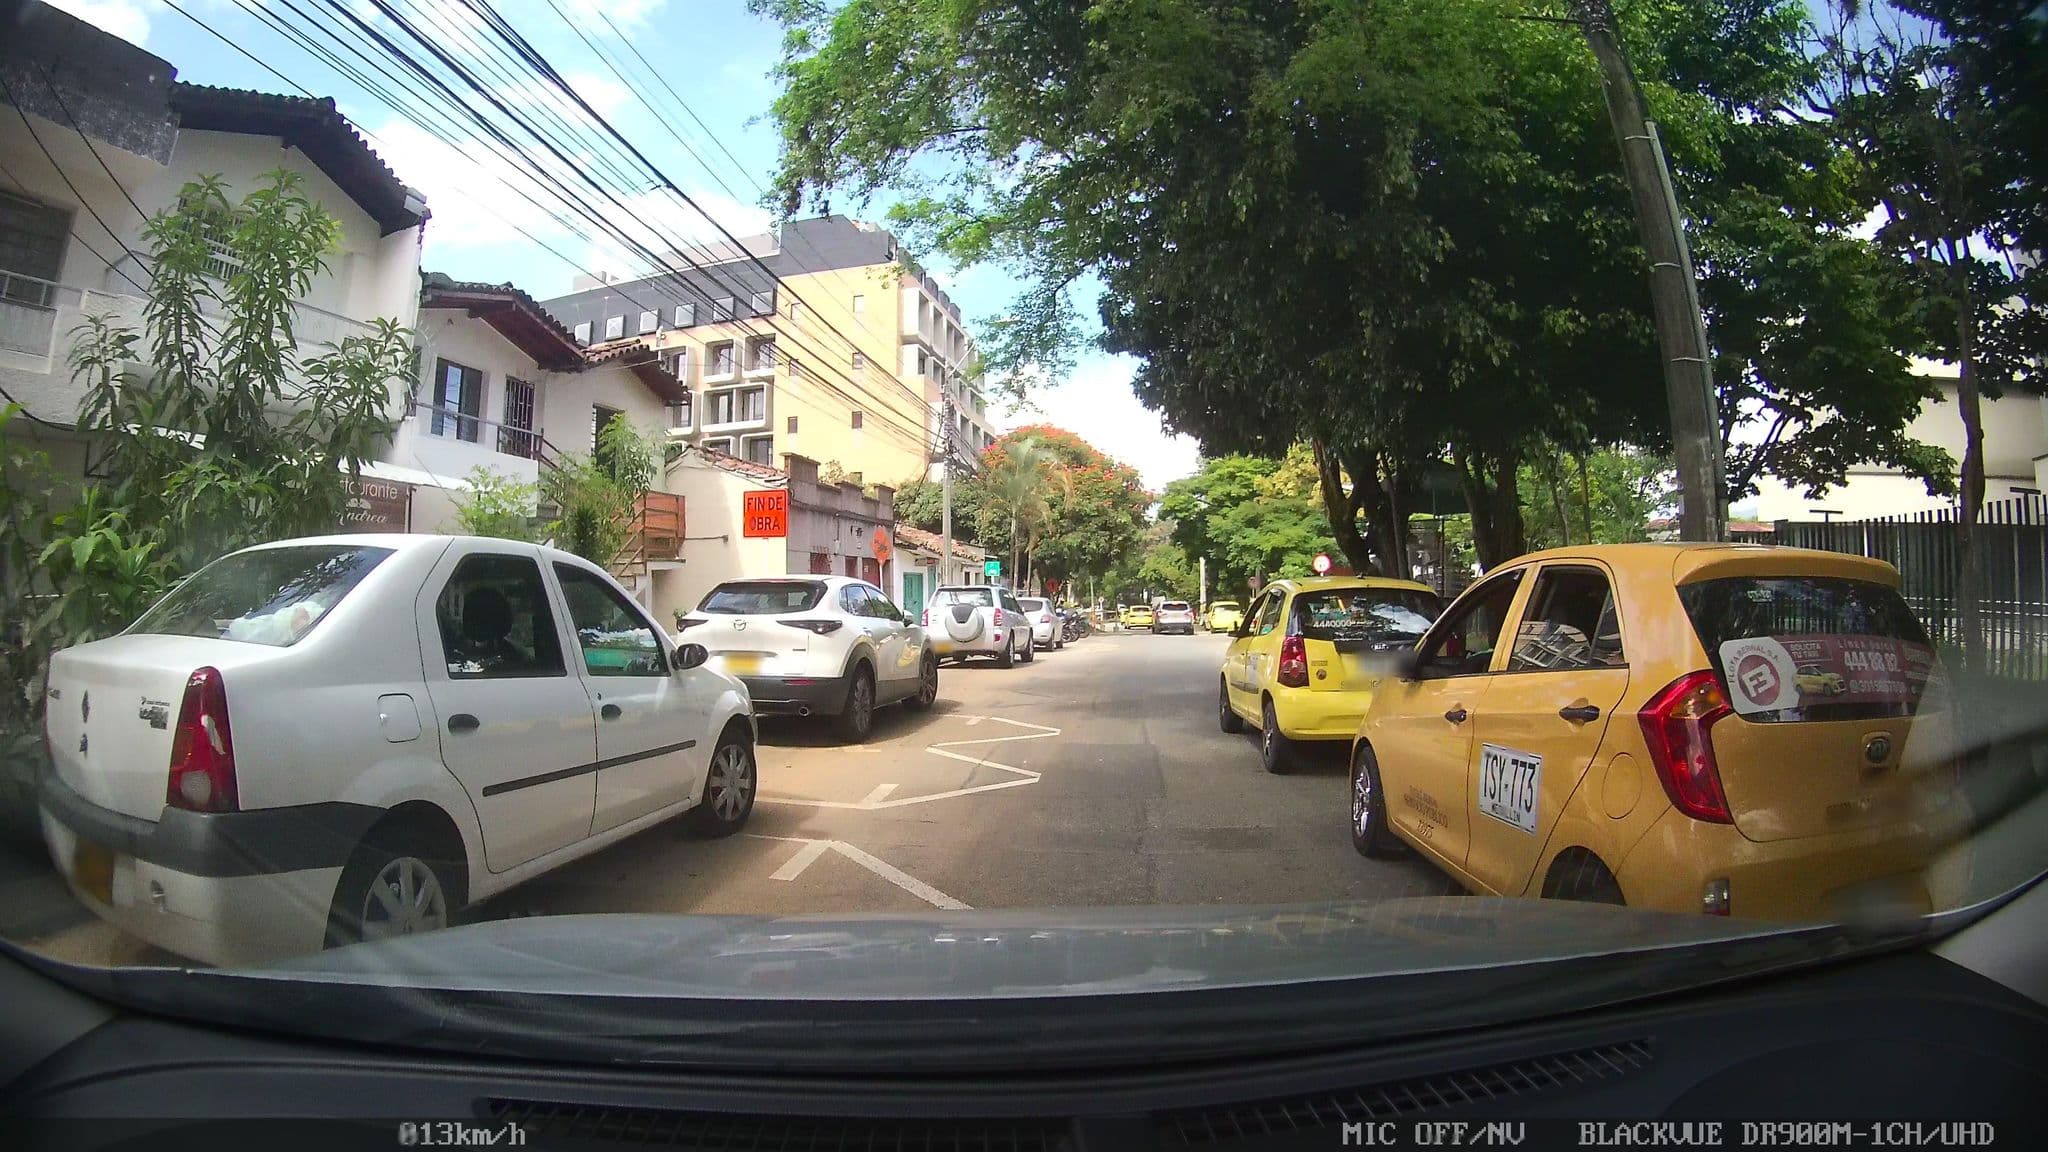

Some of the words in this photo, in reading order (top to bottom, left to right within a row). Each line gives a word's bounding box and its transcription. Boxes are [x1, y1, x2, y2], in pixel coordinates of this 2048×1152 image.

[747, 497, 765, 512] FIN
[768, 496, 783, 511] DE
[750, 516, 780, 531] OBRA
[1484, 751, 1537, 813] TSY-773
